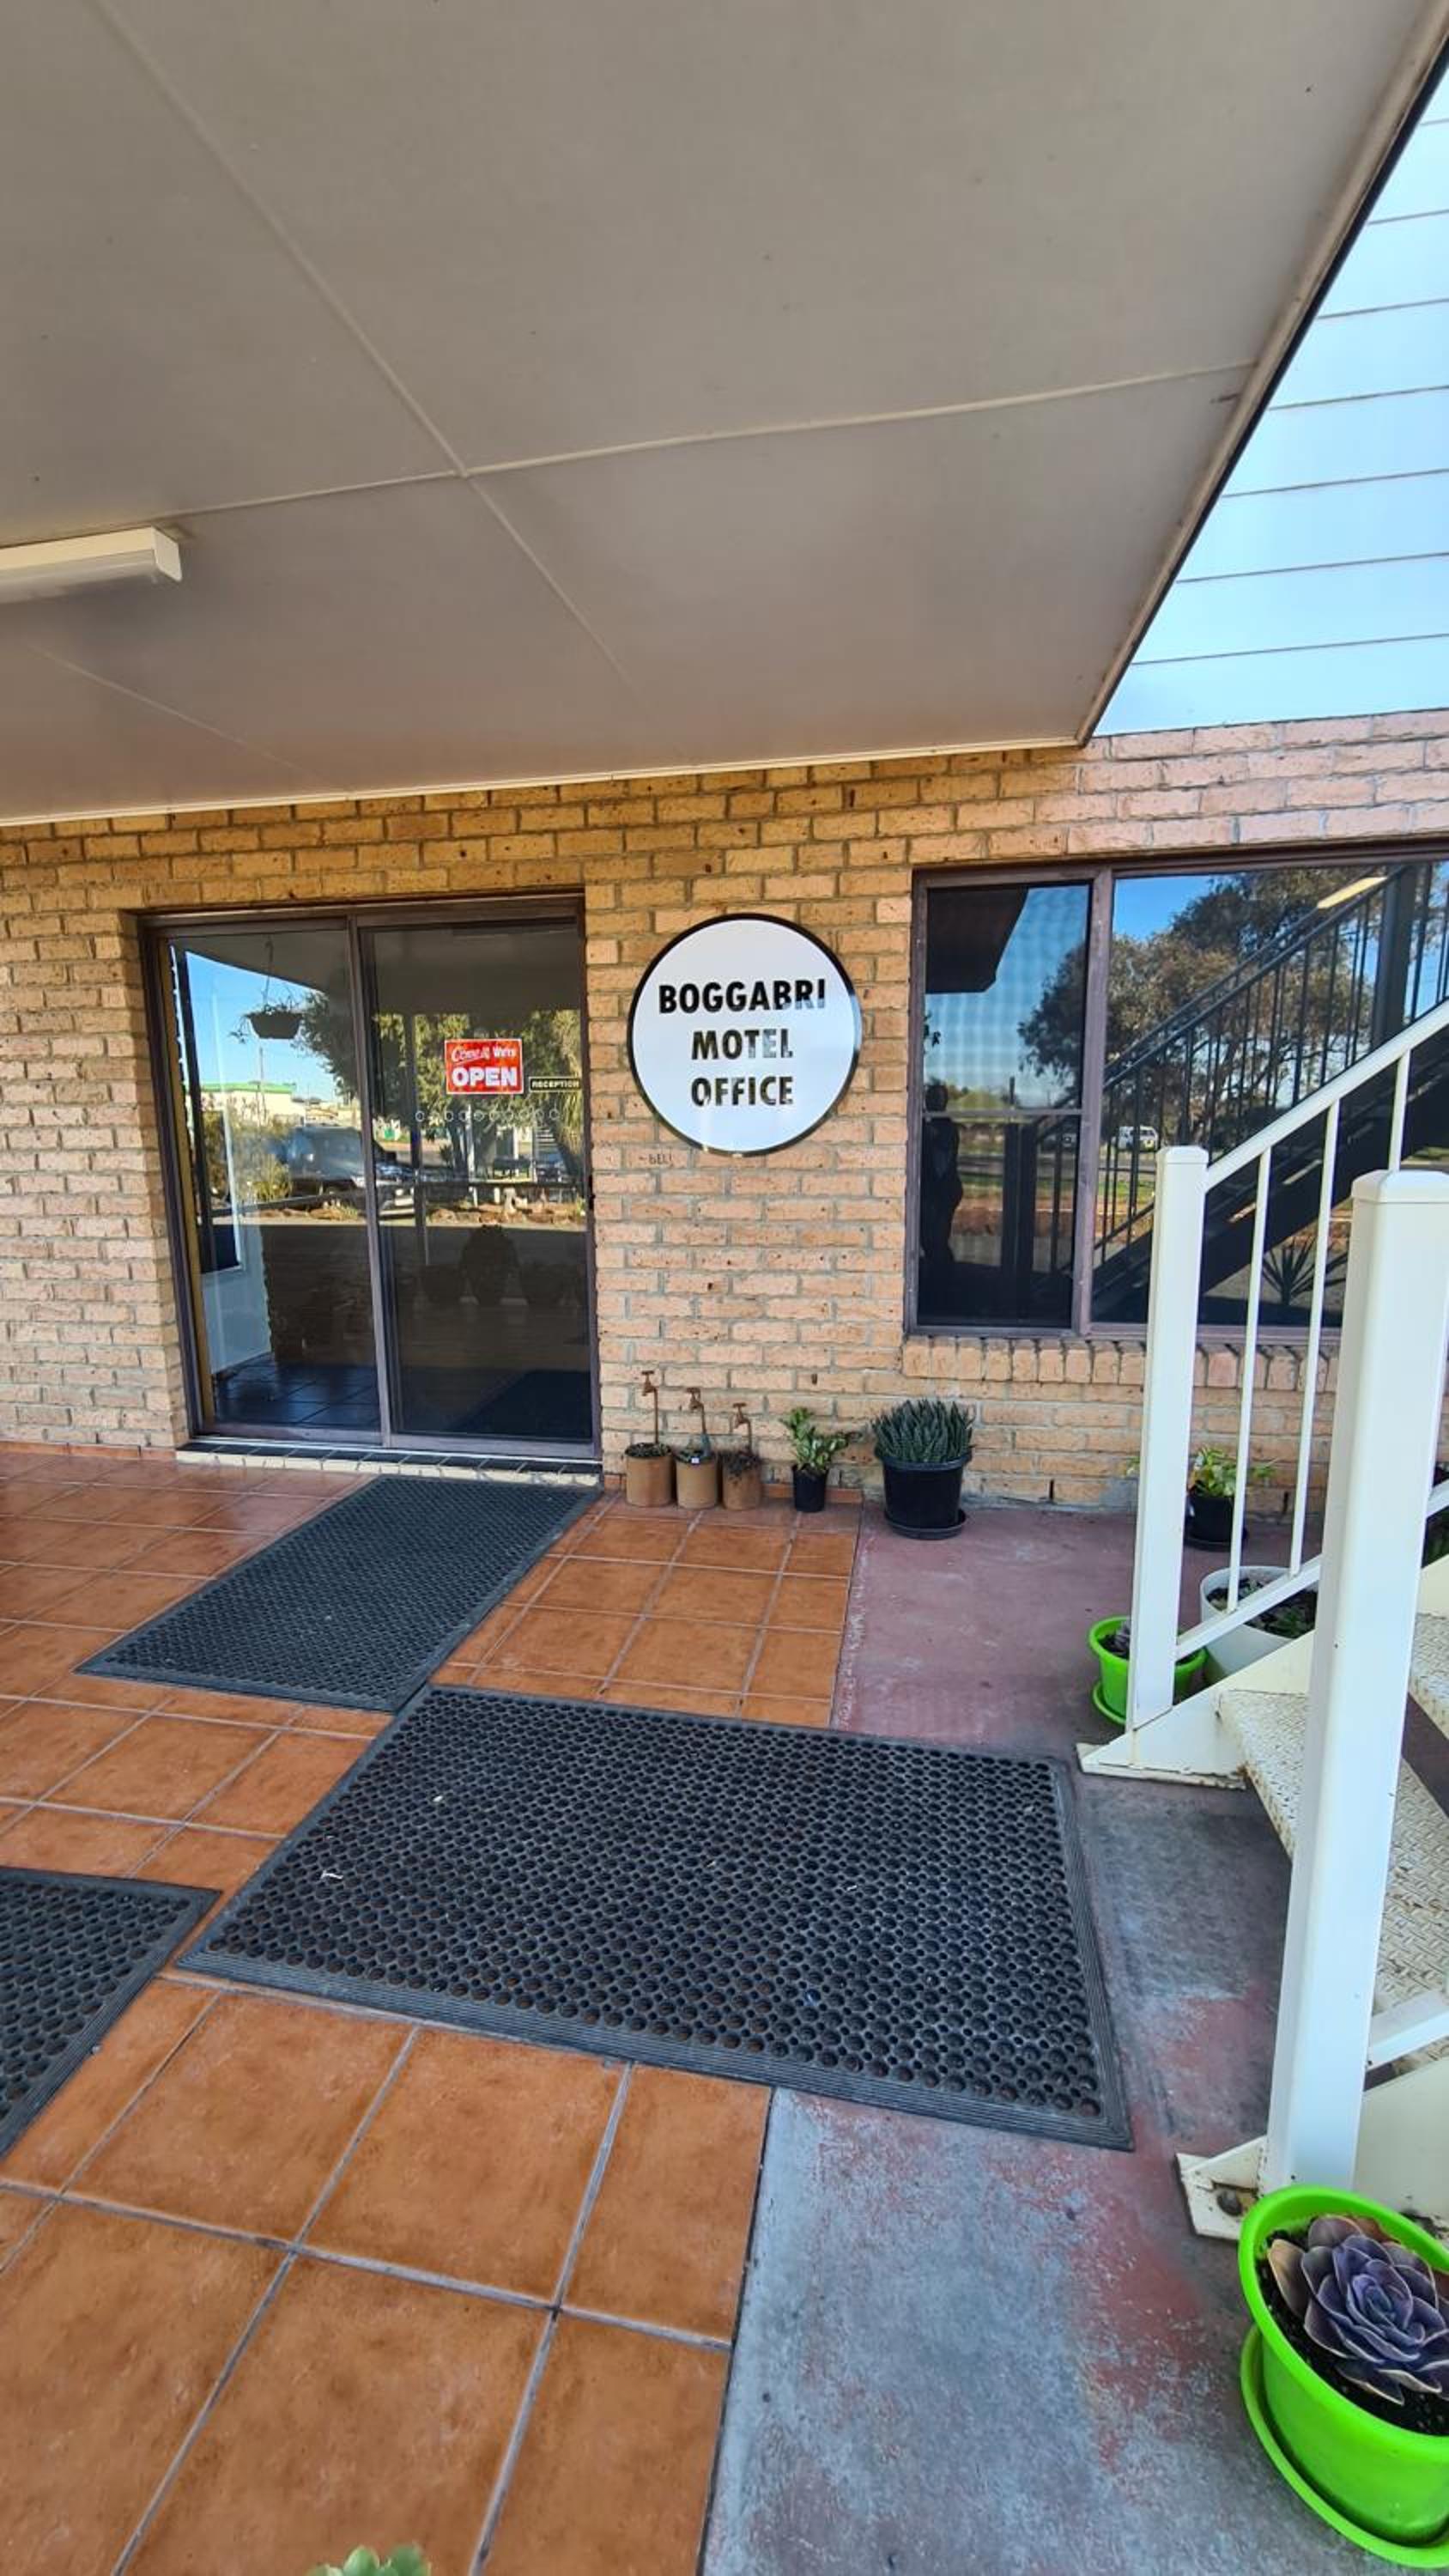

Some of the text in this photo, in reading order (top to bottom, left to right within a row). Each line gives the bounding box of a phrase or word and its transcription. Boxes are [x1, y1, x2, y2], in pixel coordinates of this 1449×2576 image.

[658, 978, 825, 1014] BOGGABRI
[691, 1029, 793, 1060] MOTEL
[452, 1066, 517, 1086] OPEN
[691, 1076, 793, 1106] OFFICE
